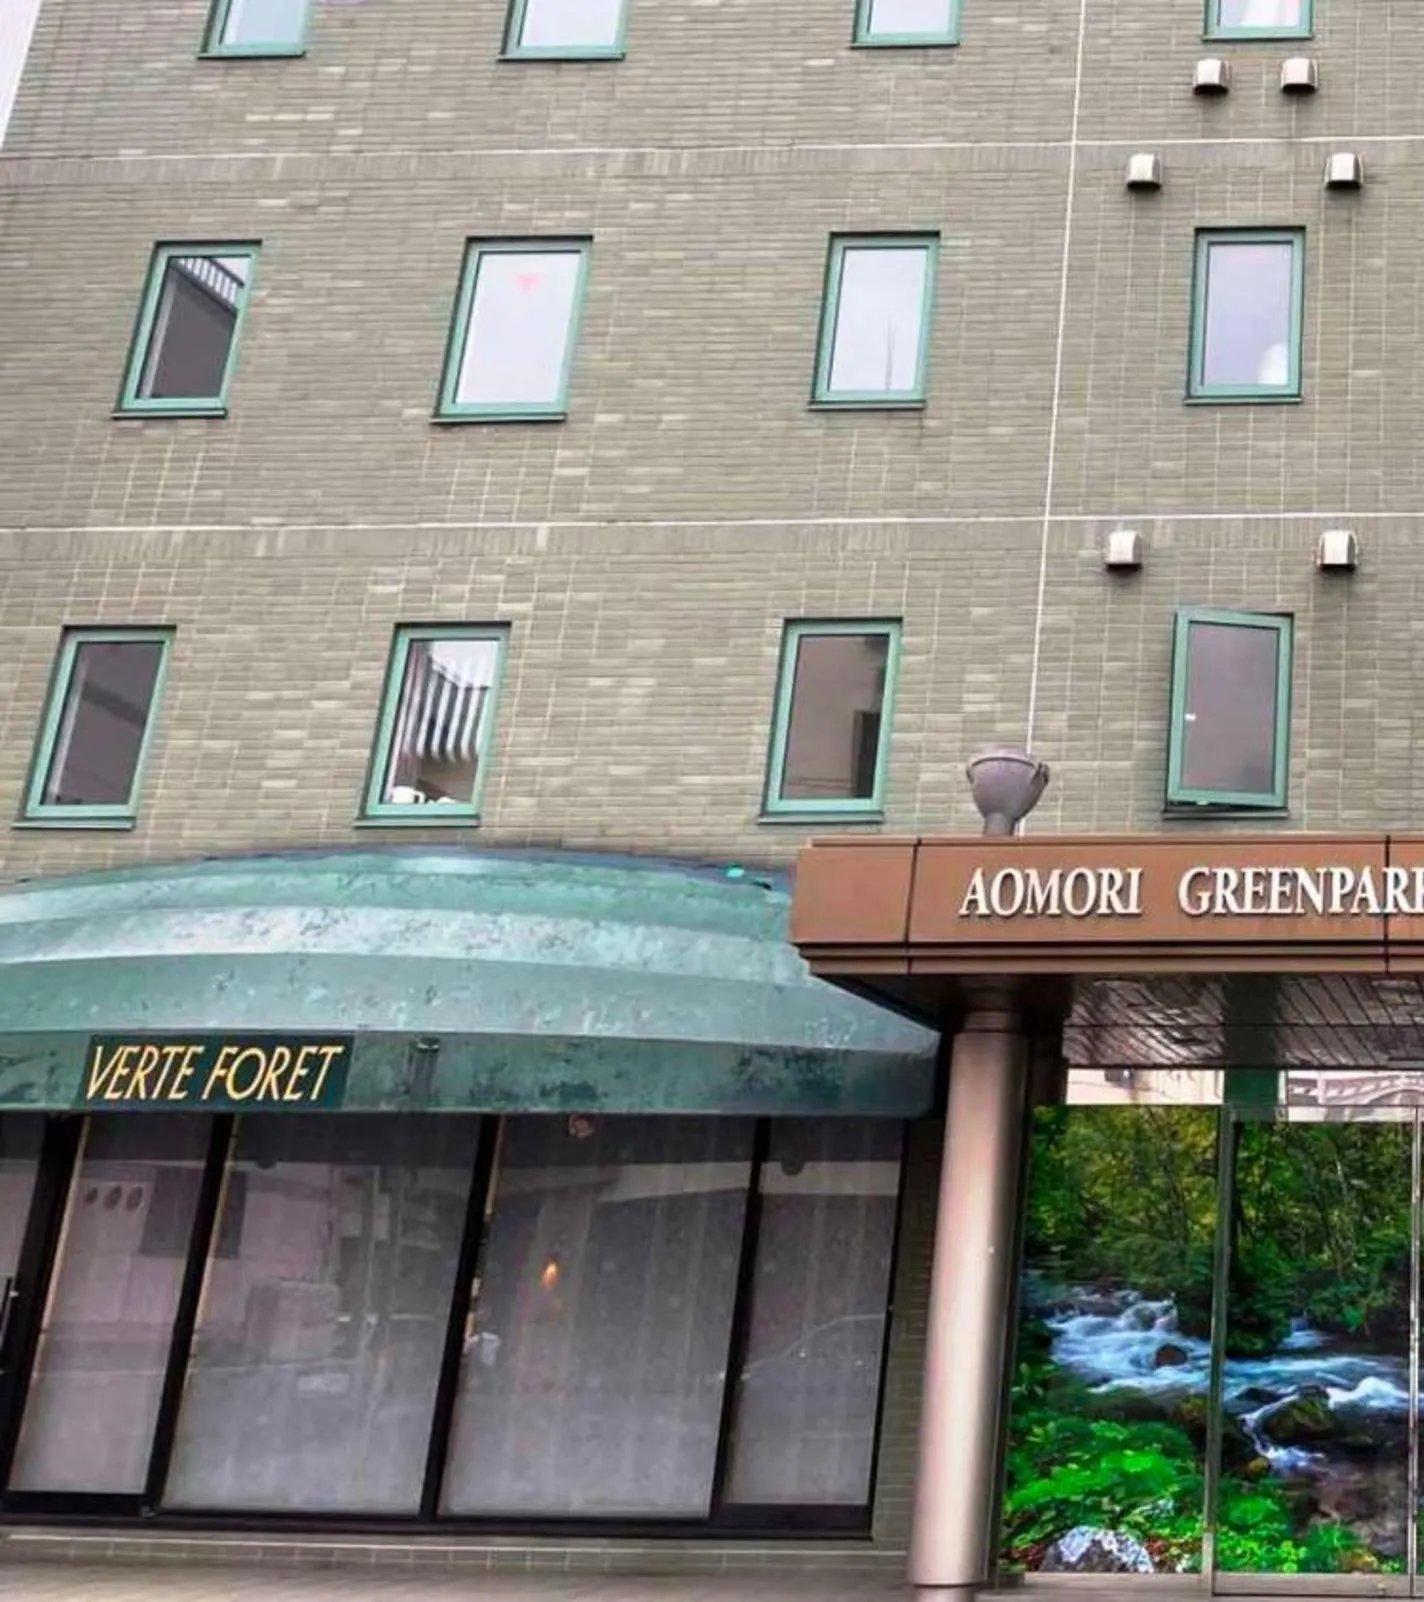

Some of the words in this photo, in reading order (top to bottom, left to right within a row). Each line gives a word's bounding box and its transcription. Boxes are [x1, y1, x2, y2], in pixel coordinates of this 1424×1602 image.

[958, 867, 1143, 916] AOMORI
[86, 1045, 205, 1100] VERTE
[201, 1045, 345, 1101] FORET
